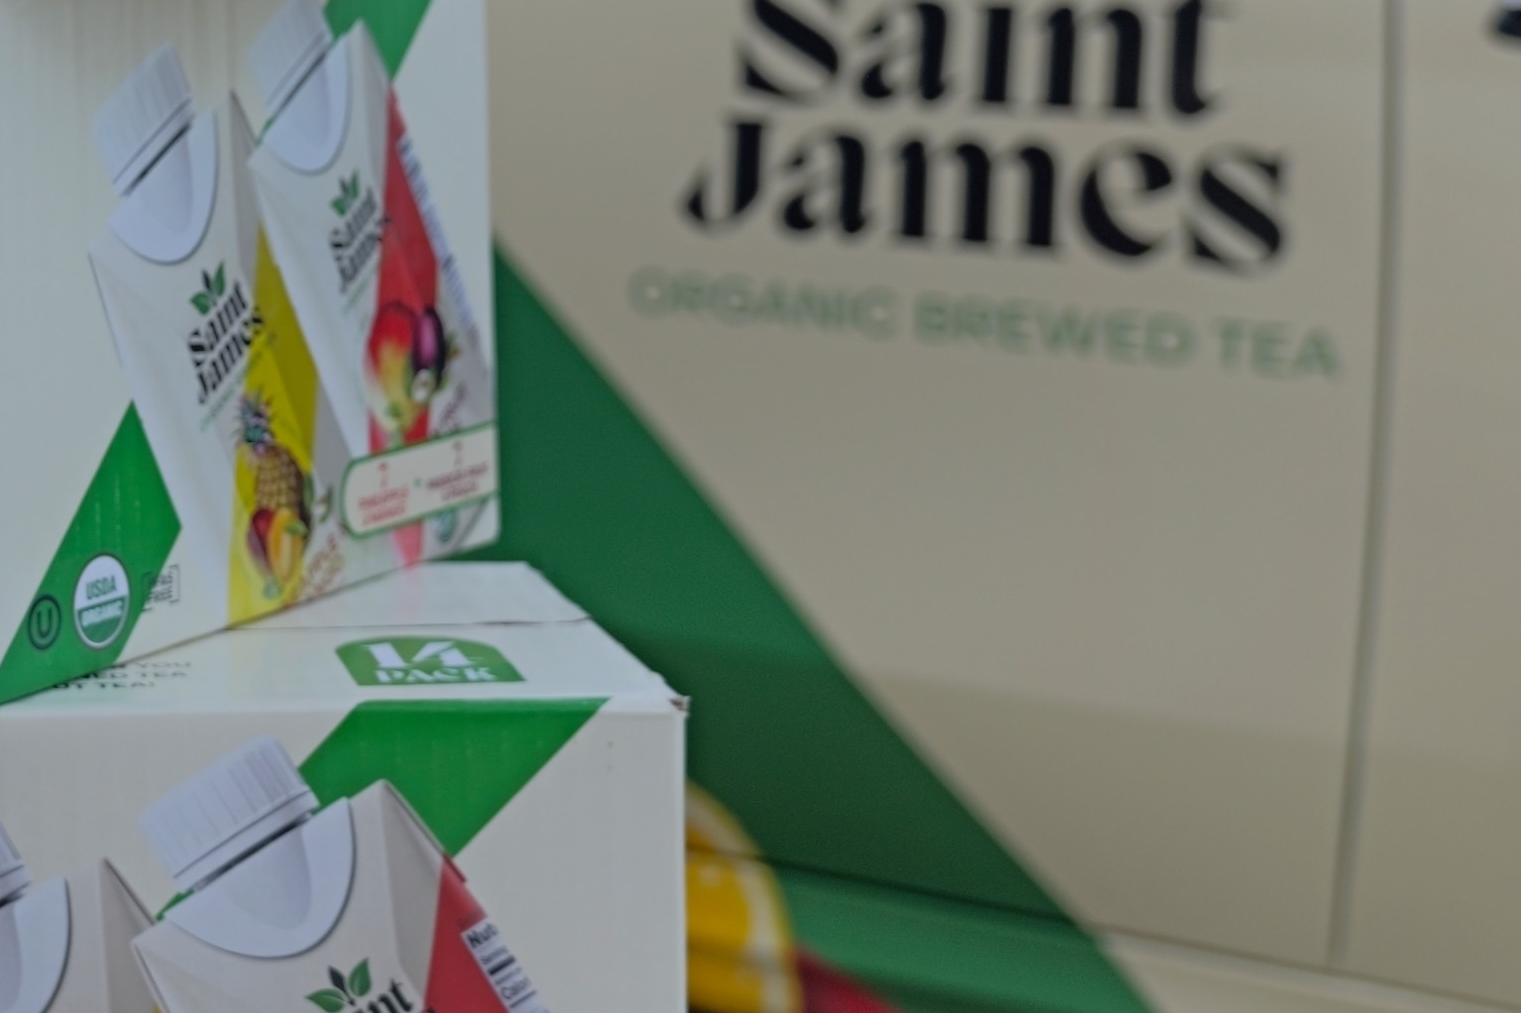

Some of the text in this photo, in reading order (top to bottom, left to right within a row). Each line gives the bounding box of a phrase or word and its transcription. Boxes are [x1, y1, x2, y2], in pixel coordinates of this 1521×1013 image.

[680, 116, 1289, 275] James
[630, 268, 1341, 380] ORGANIC BREWED TEA
[86, 575, 117, 600] USDA
[363, 641, 481, 669] 14
[373, 667, 499, 684] PACK
